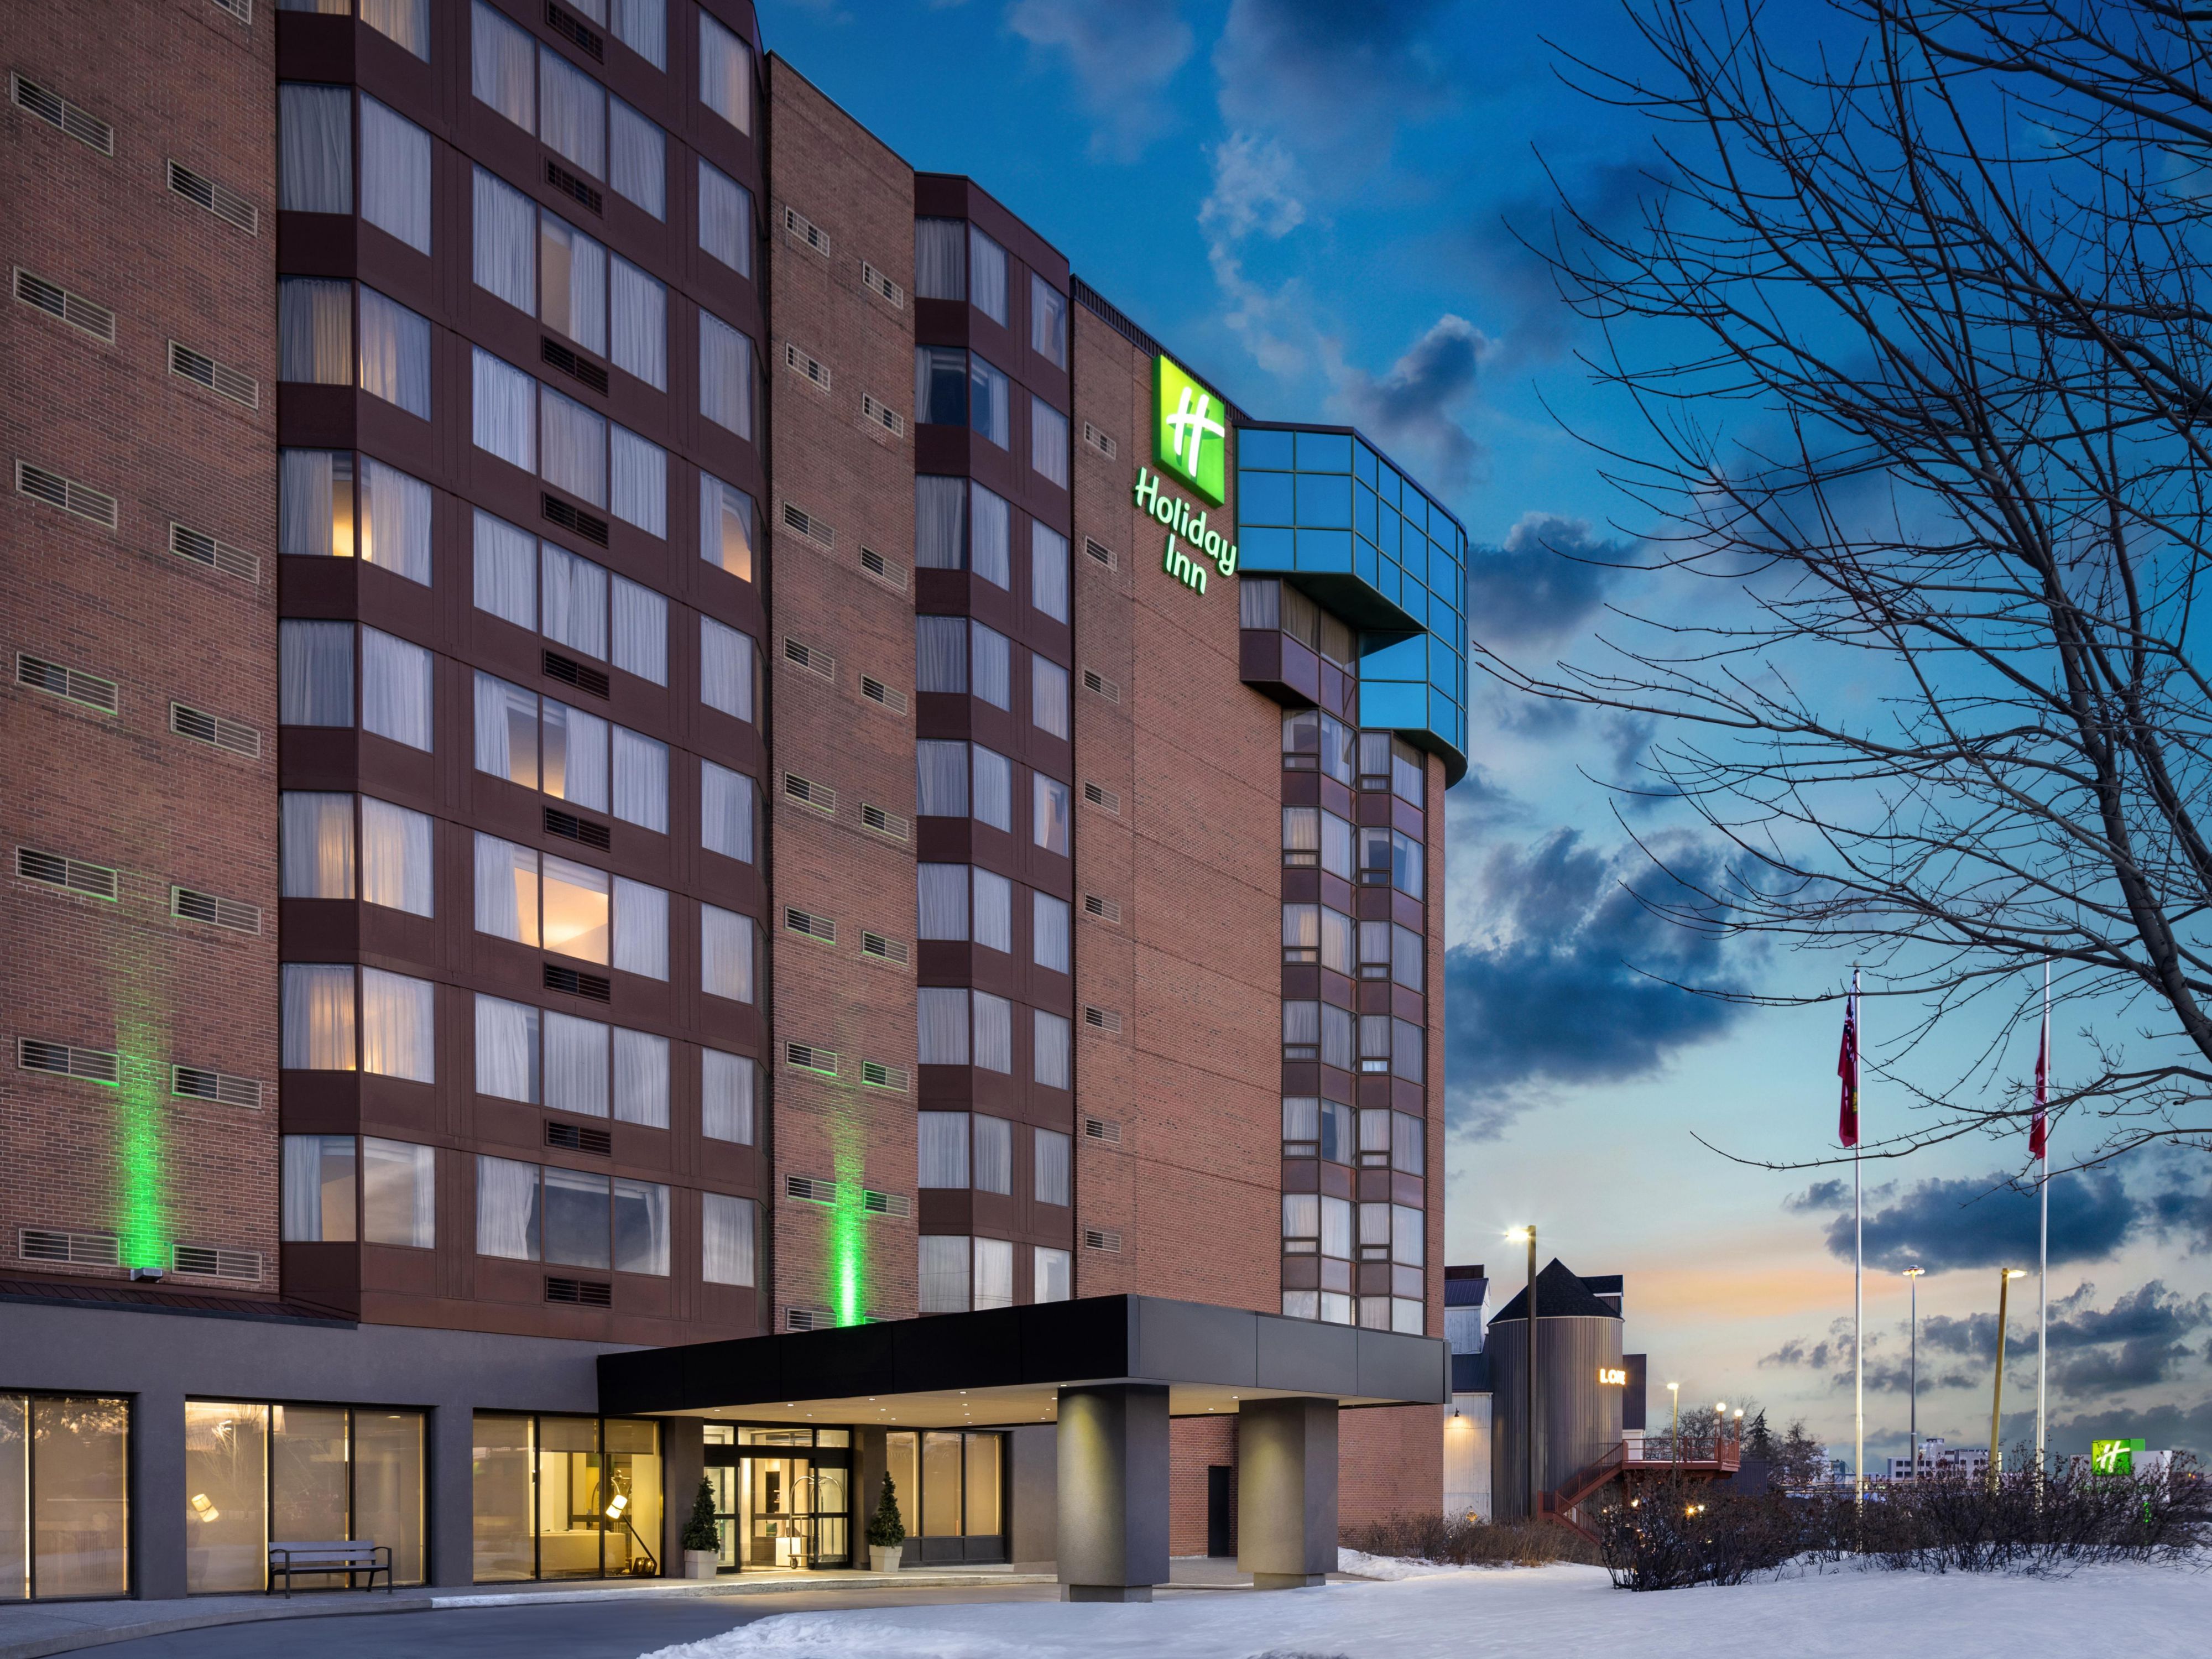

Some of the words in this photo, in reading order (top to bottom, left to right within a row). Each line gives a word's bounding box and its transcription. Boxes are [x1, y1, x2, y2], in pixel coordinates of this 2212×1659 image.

[1166, 386, 1224, 477] H
[1134, 466, 1237, 576] Holiday
[1165, 533, 1207, 594] Inn
